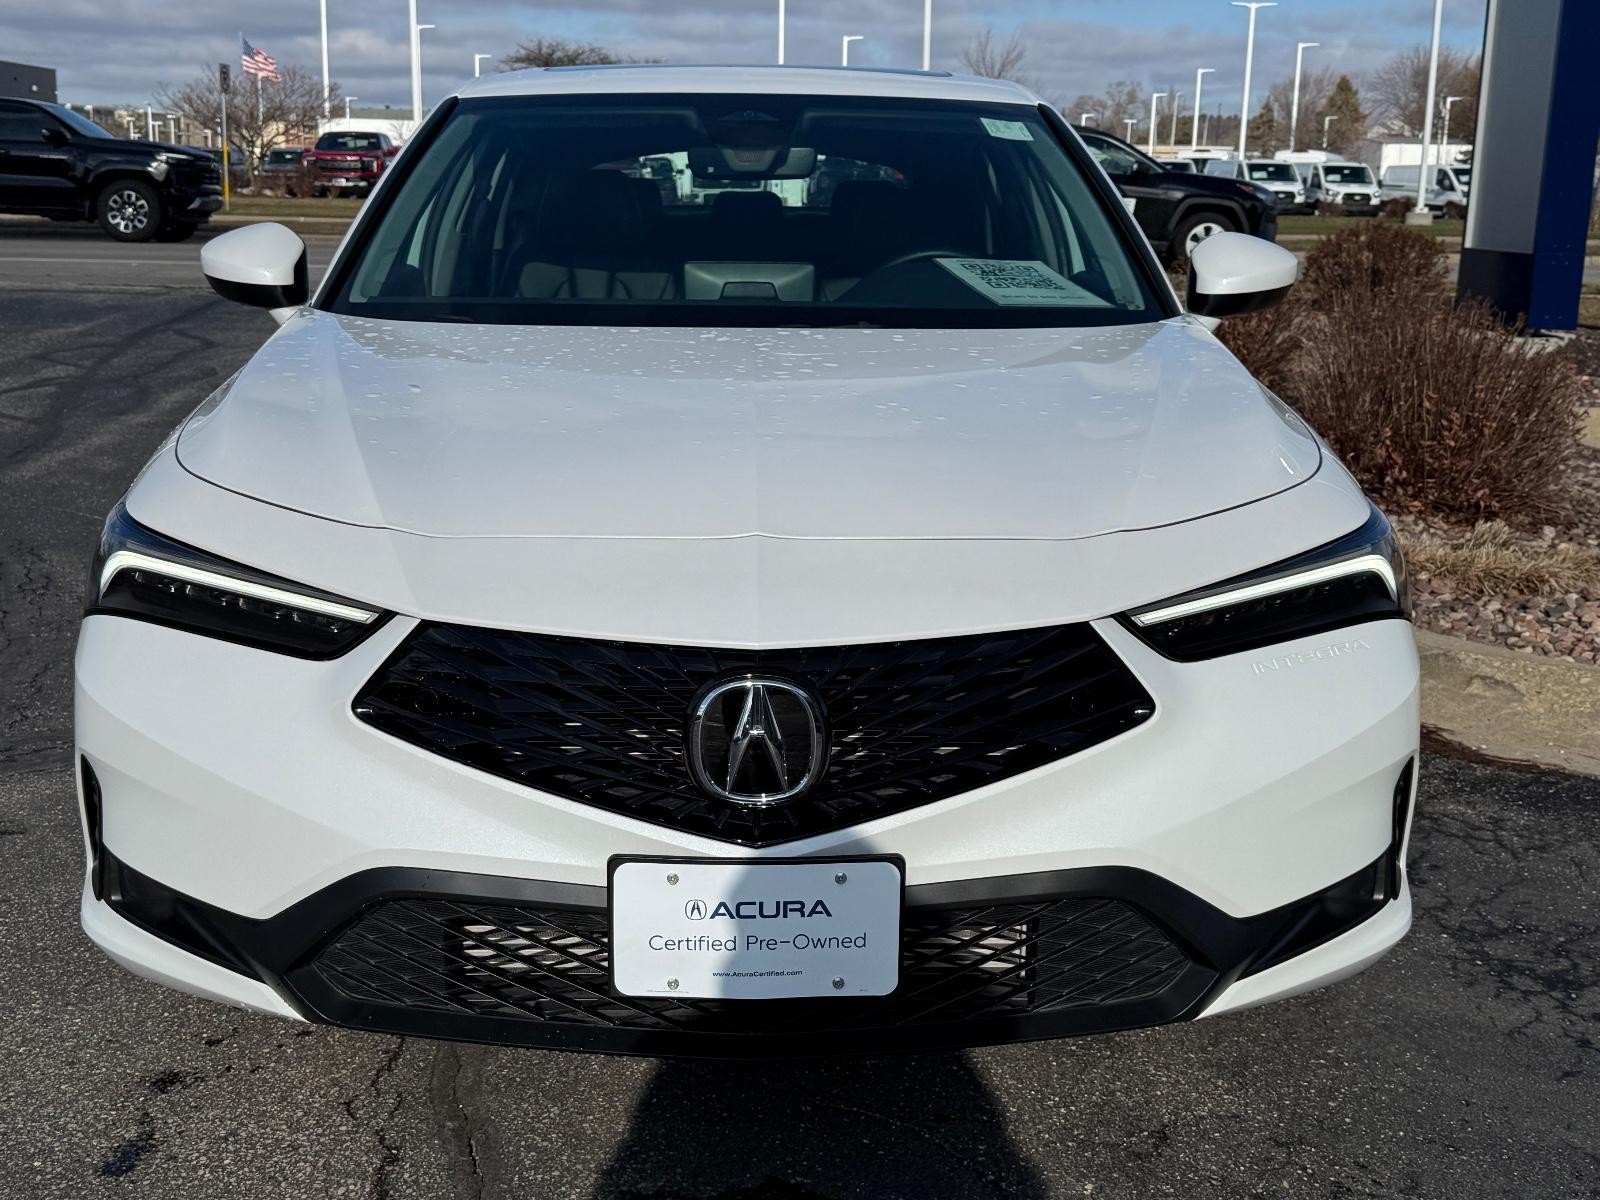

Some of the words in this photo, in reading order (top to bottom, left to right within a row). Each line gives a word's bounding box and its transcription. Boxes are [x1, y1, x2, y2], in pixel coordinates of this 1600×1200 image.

[1251, 639, 1371, 675] INTEGRA
[709, 900, 833, 920] ACURA
[648, 935, 737, 951] Certified
[746, 932, 867, 951] Pre-Owned
[712, 969, 803, 978] www.AcuraCertified.com
